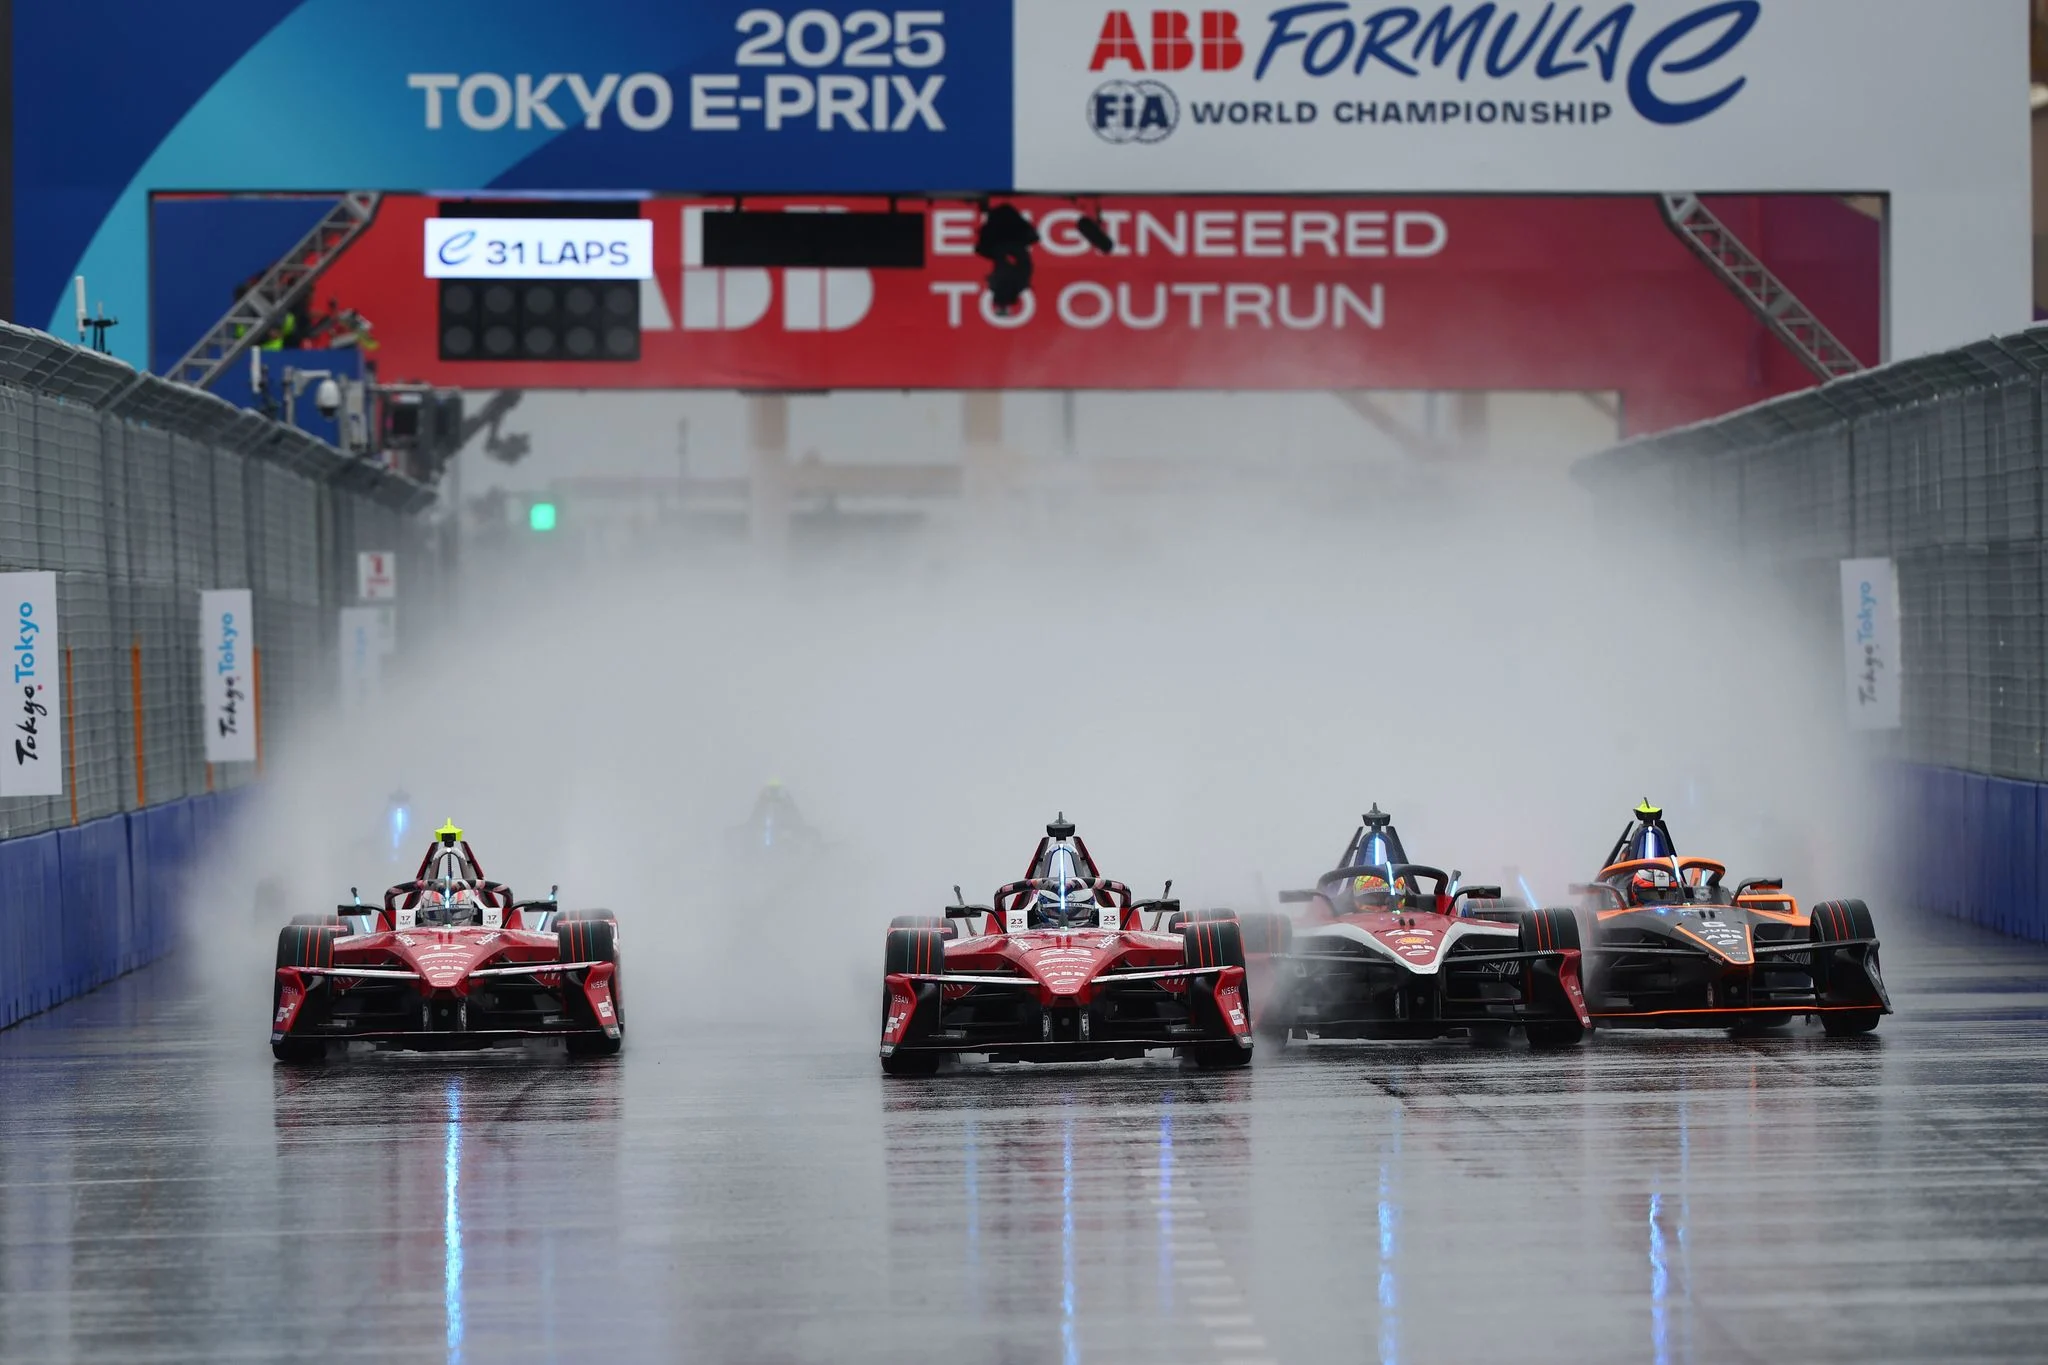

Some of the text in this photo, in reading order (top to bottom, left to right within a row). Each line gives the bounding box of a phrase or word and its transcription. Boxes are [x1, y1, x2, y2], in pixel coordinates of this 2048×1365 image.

[735, 10, 945, 67] 2025
[1088, 10, 1244, 72] ABB
[1253, 0, 1635, 82] FORMULA
[408, 73, 945, 131] TOKYO E-PRIX
[1190, 100, 1612, 125] WORLD CHAMPIONSHIP
[486, 240, 525, 266] 31
[537, 240, 630, 267] LAPS
[931, 208, 1449, 257] EGINEERED
[929, 280, 1385, 330] TO OUTRUN
[218, 611, 238, 675] Tokyo
[14, 602, 47, 766] Tokyo Tokyo
